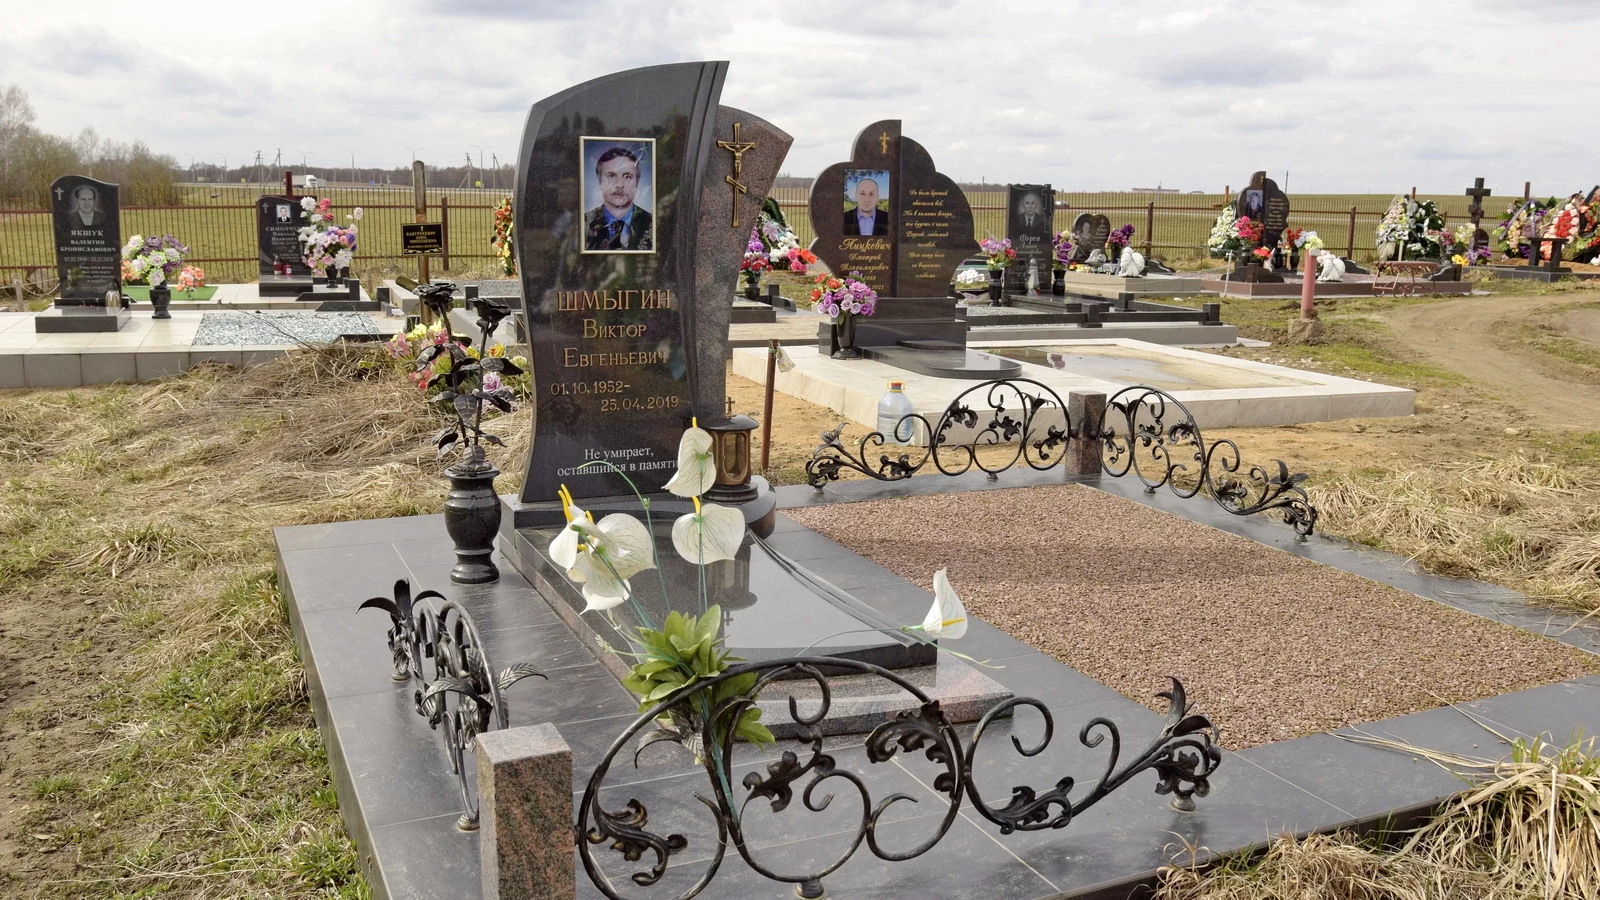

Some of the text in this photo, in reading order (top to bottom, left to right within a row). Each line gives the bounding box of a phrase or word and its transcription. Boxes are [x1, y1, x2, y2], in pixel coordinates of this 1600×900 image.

[557, 289, 671, 311] ШМЫГИН
[582, 318, 647, 339] Виктор
[563, 347, 668, 368] Евгеньевич
[550, 380, 631, 396] 01.10.1952-
[600, 395, 679, 412] 25.04.2019
[584, 446, 654, 461] Не умирает,
[557, 462, 626, 477] оставшийся
[639, 460, 679, 471] памяти
